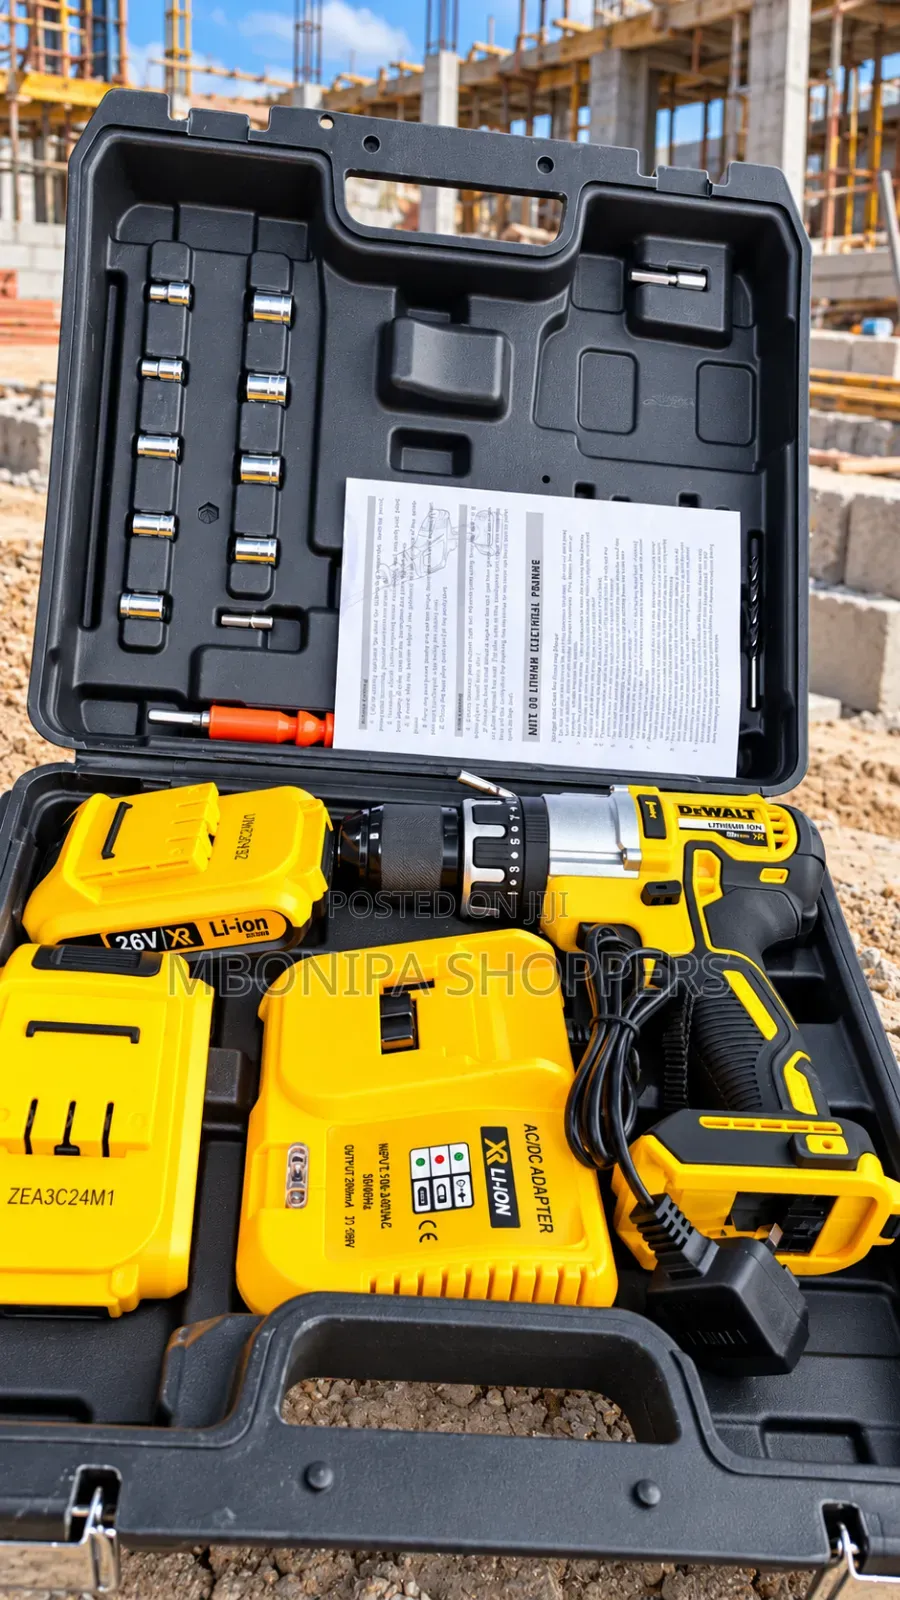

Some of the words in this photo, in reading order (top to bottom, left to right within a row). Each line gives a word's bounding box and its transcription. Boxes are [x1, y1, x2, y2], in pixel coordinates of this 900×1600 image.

[115, 931, 157, 951] 26V
[209, 917, 270, 938] Li-ion
[523, 1123, 543, 1164] AC/DC
[7, 1187, 115, 1206] ZEA3C24M1
[490, 1167, 512, 1216] LI-ION
[530, 1166, 554, 1234] ADAPTER
[418, 1220, 438, 1244] CE
